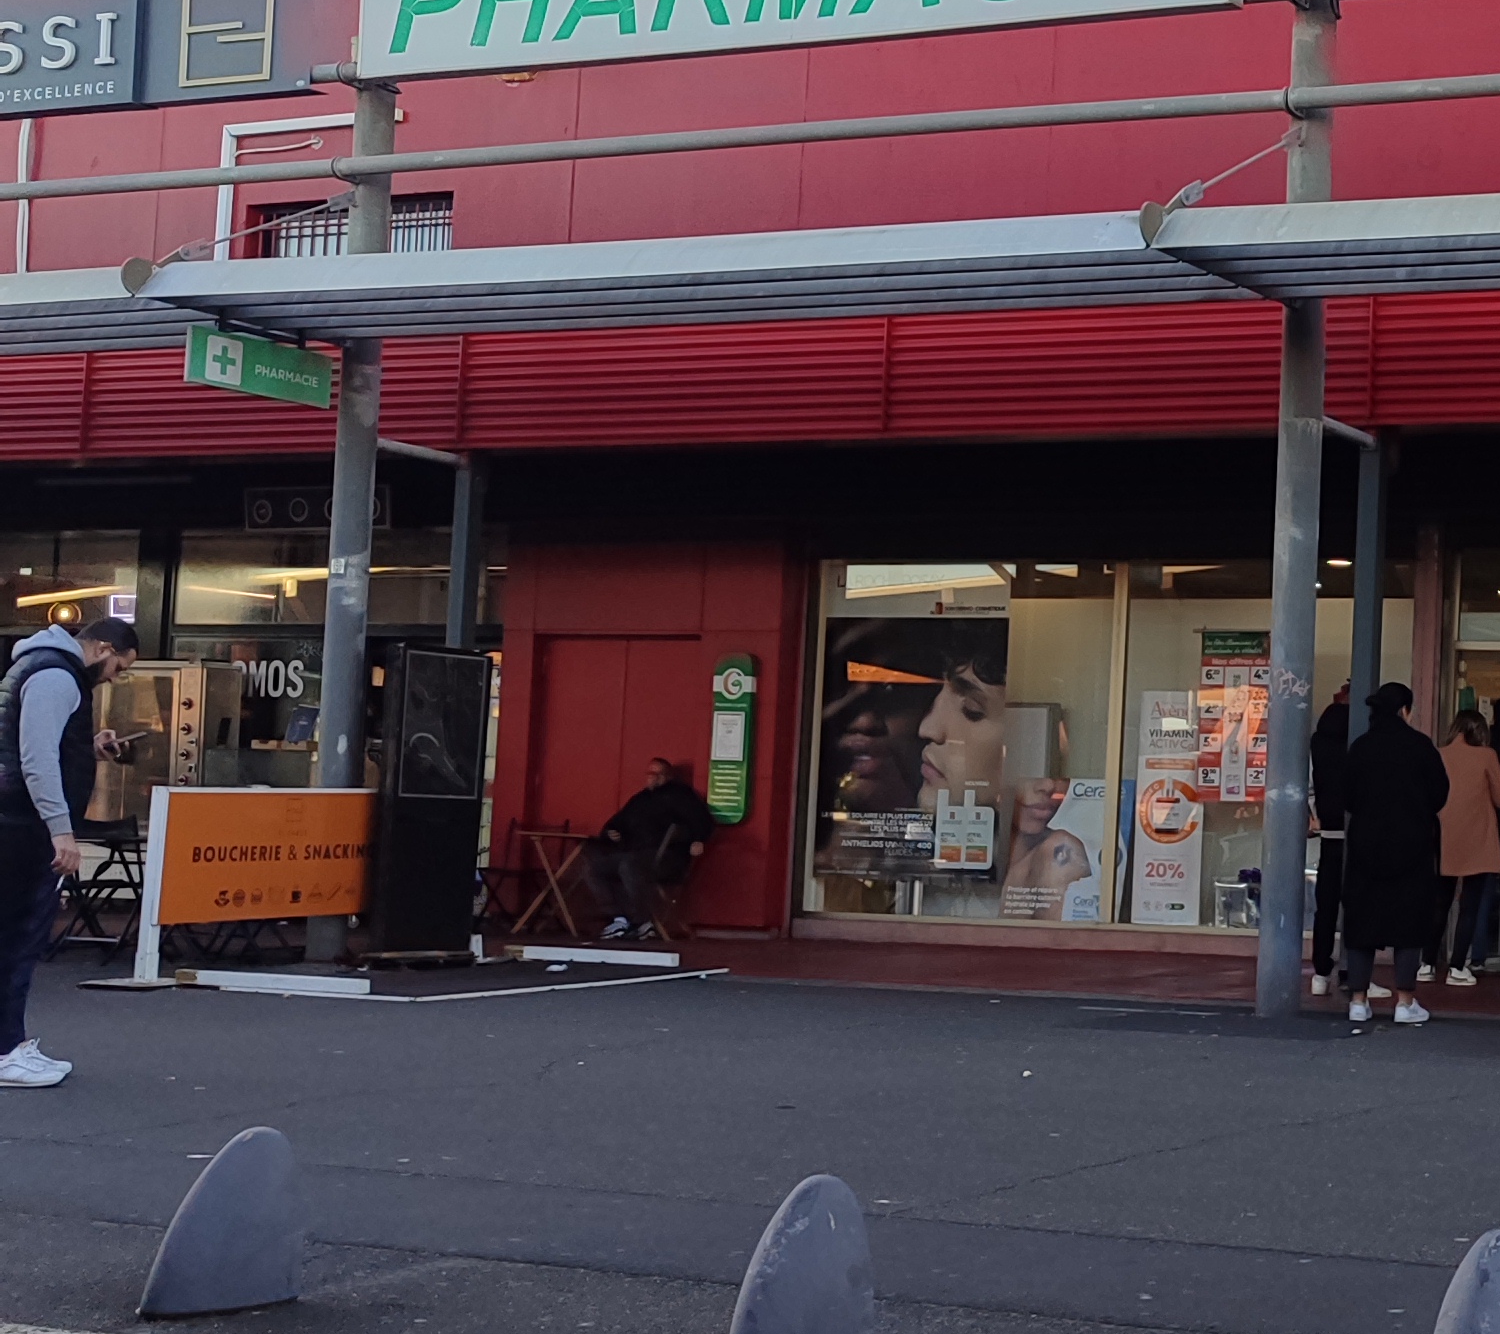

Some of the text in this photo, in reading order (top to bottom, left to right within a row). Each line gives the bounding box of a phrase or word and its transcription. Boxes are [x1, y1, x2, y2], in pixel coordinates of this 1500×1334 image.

[254, 364, 320, 387] PHARMACIE
[1229, 657, 1253, 665] offres
[232, 660, 304, 698] MOS
[1149, 729, 1195, 739] VITAMIN
[841, 839, 884, 848] ANTHELIOS
[192, 842, 374, 863] BOUCHERIE & SNACKIN
[1145, 862, 1184, 879] 20%
